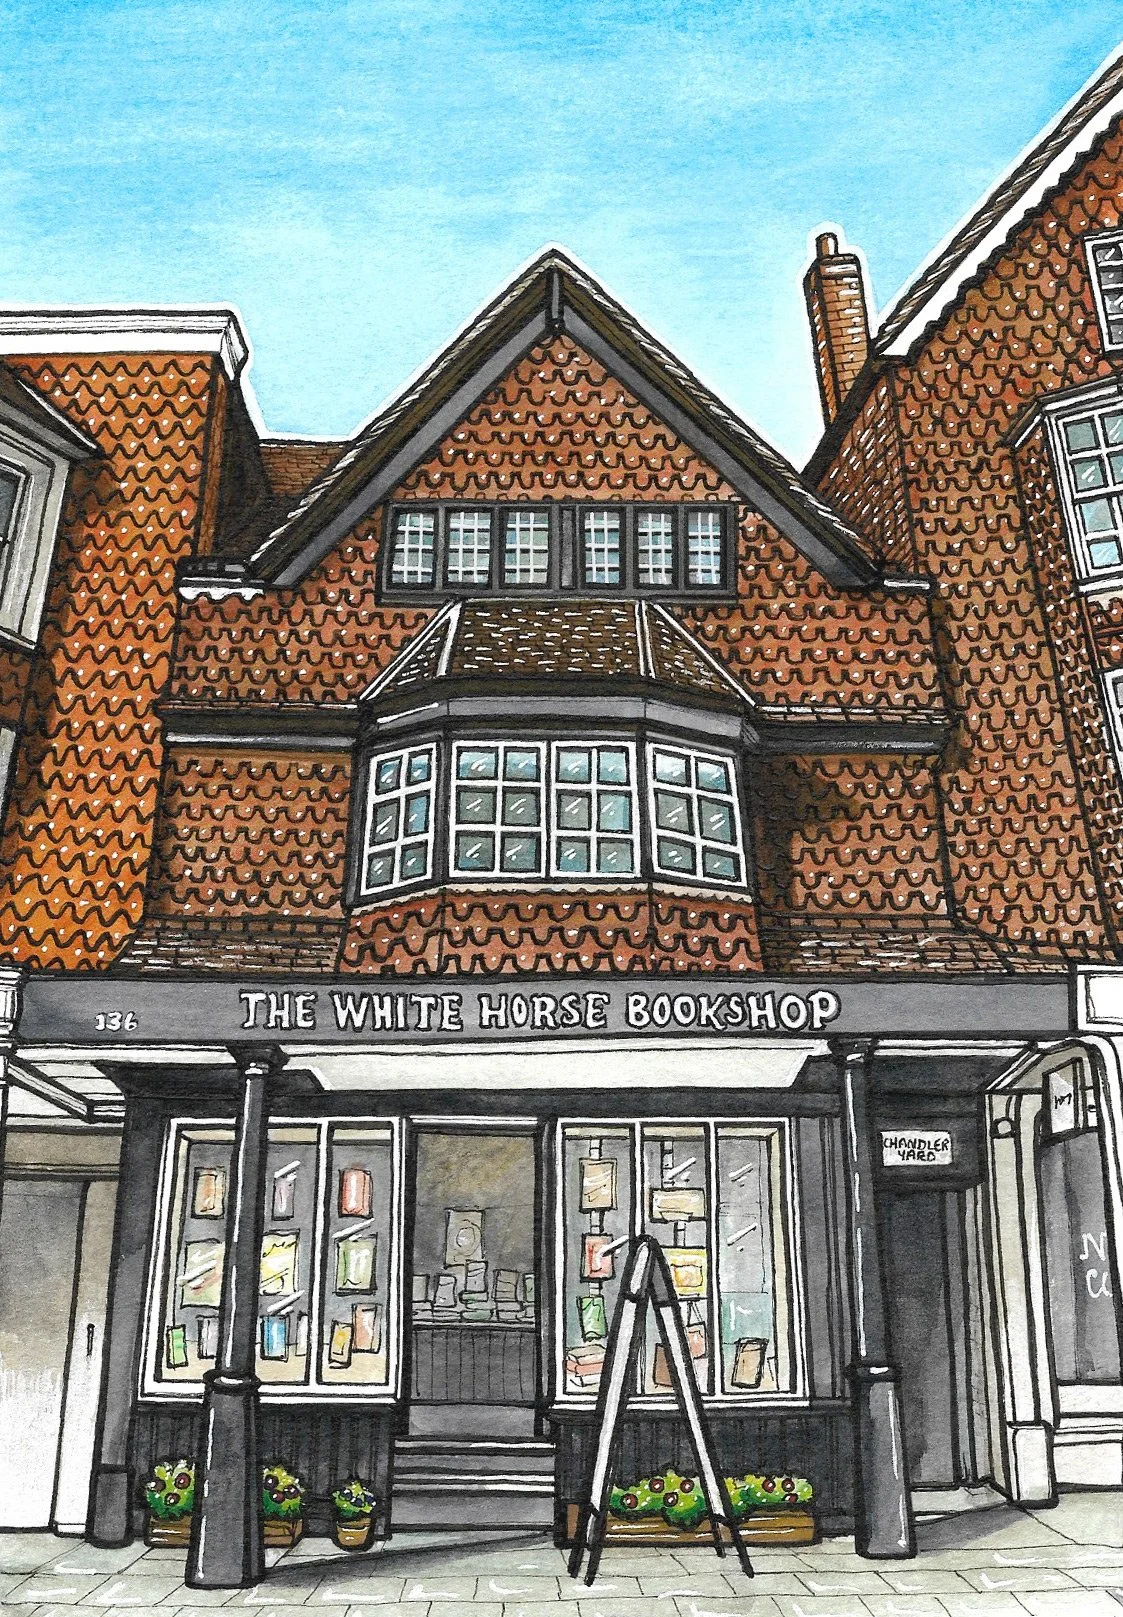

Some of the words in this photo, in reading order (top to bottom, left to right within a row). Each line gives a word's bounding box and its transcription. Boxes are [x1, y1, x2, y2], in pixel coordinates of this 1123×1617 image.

[240, 990, 318, 1030] THE
[329, 990, 463, 1032] WHITE
[478, 991, 610, 1030] HORSE
[625, 989, 842, 1030] BOOKSHOP
[95, 1011, 138, 1032] 136
[883, 1136, 950, 1151] CHANDLER
[897, 1149, 936, 1162] YARD
